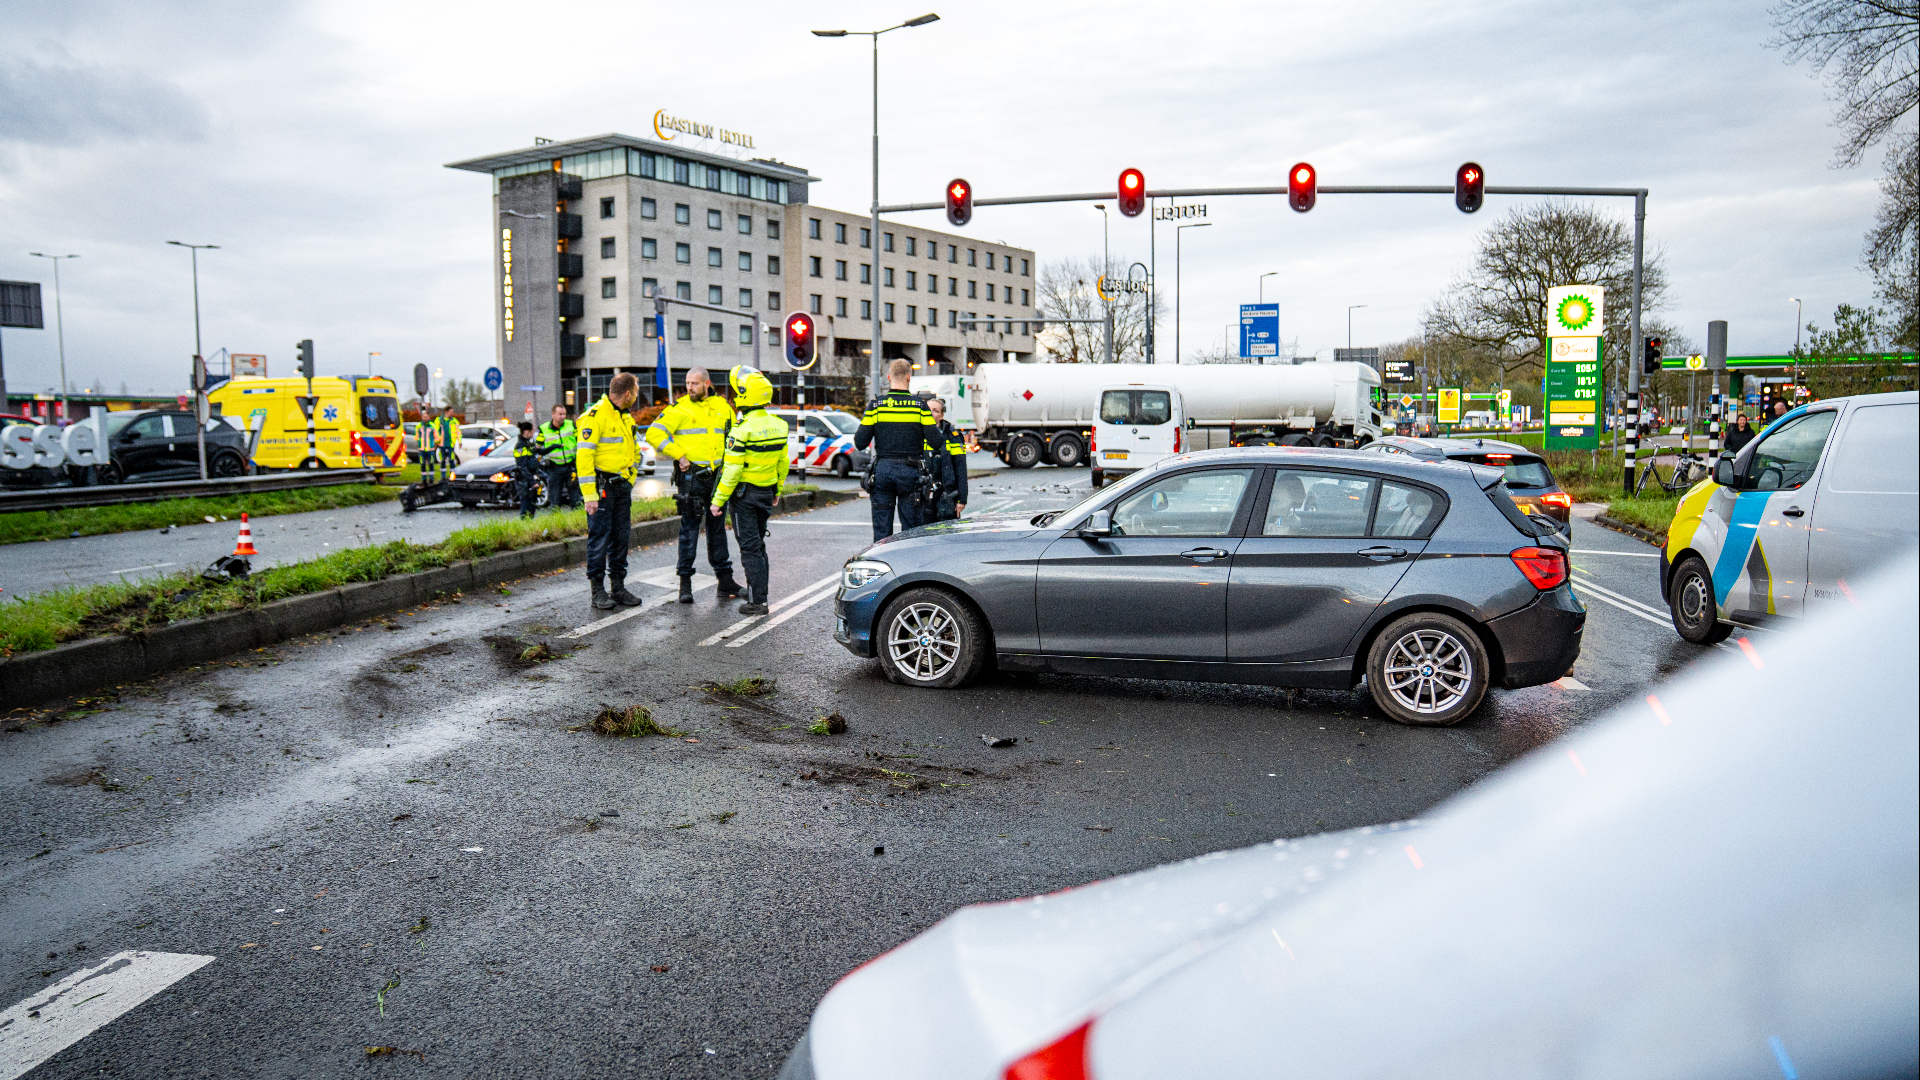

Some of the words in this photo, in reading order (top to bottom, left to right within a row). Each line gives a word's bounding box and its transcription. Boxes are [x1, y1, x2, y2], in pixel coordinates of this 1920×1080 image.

[660, 113, 714, 139] BASTION
[719, 128, 756, 149] HOTEL
[502, 228, 514, 342] RESTAURANT
